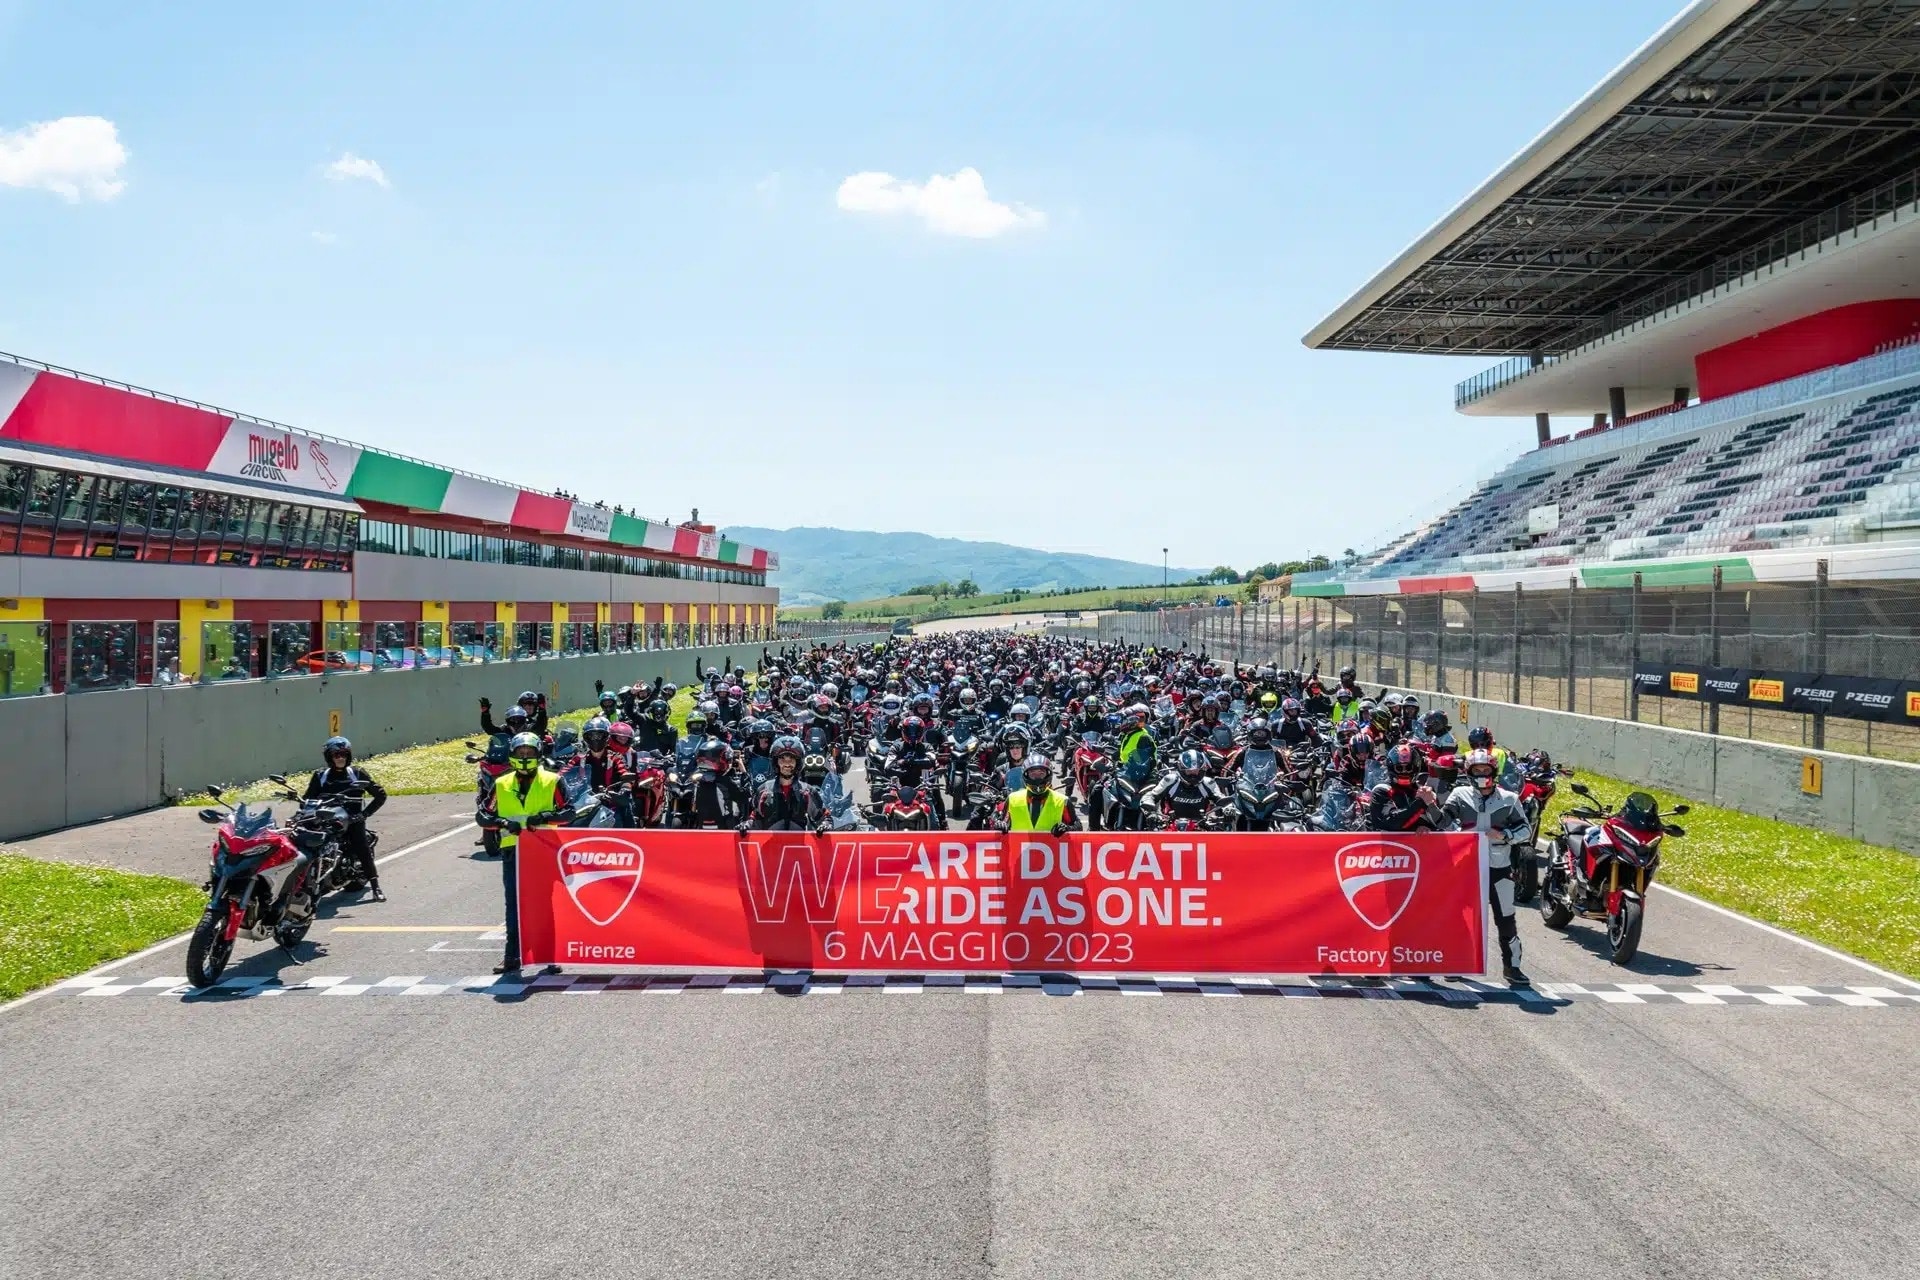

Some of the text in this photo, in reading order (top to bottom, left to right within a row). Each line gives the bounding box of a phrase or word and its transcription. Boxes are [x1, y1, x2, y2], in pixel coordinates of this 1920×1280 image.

[248, 433, 299, 471] mugello
[240, 463, 288, 483] CIRCUIT
[1672, 675, 1696, 690] PIRELLI
[332, 714, 339, 733] 2
[566, 851, 635, 867] DUCATI
[1344, 854, 1411, 870] DUCATI
[738, 841, 1223, 924] WE ARE DUCATI.
[892, 886, 1223, 927] RIDE AS ONE.
[567, 940, 636, 959] Firenze
[823, 931, 1135, 964] 6 MAGGIO 2023
[1317, 945, 1444, 968] Factory Store
